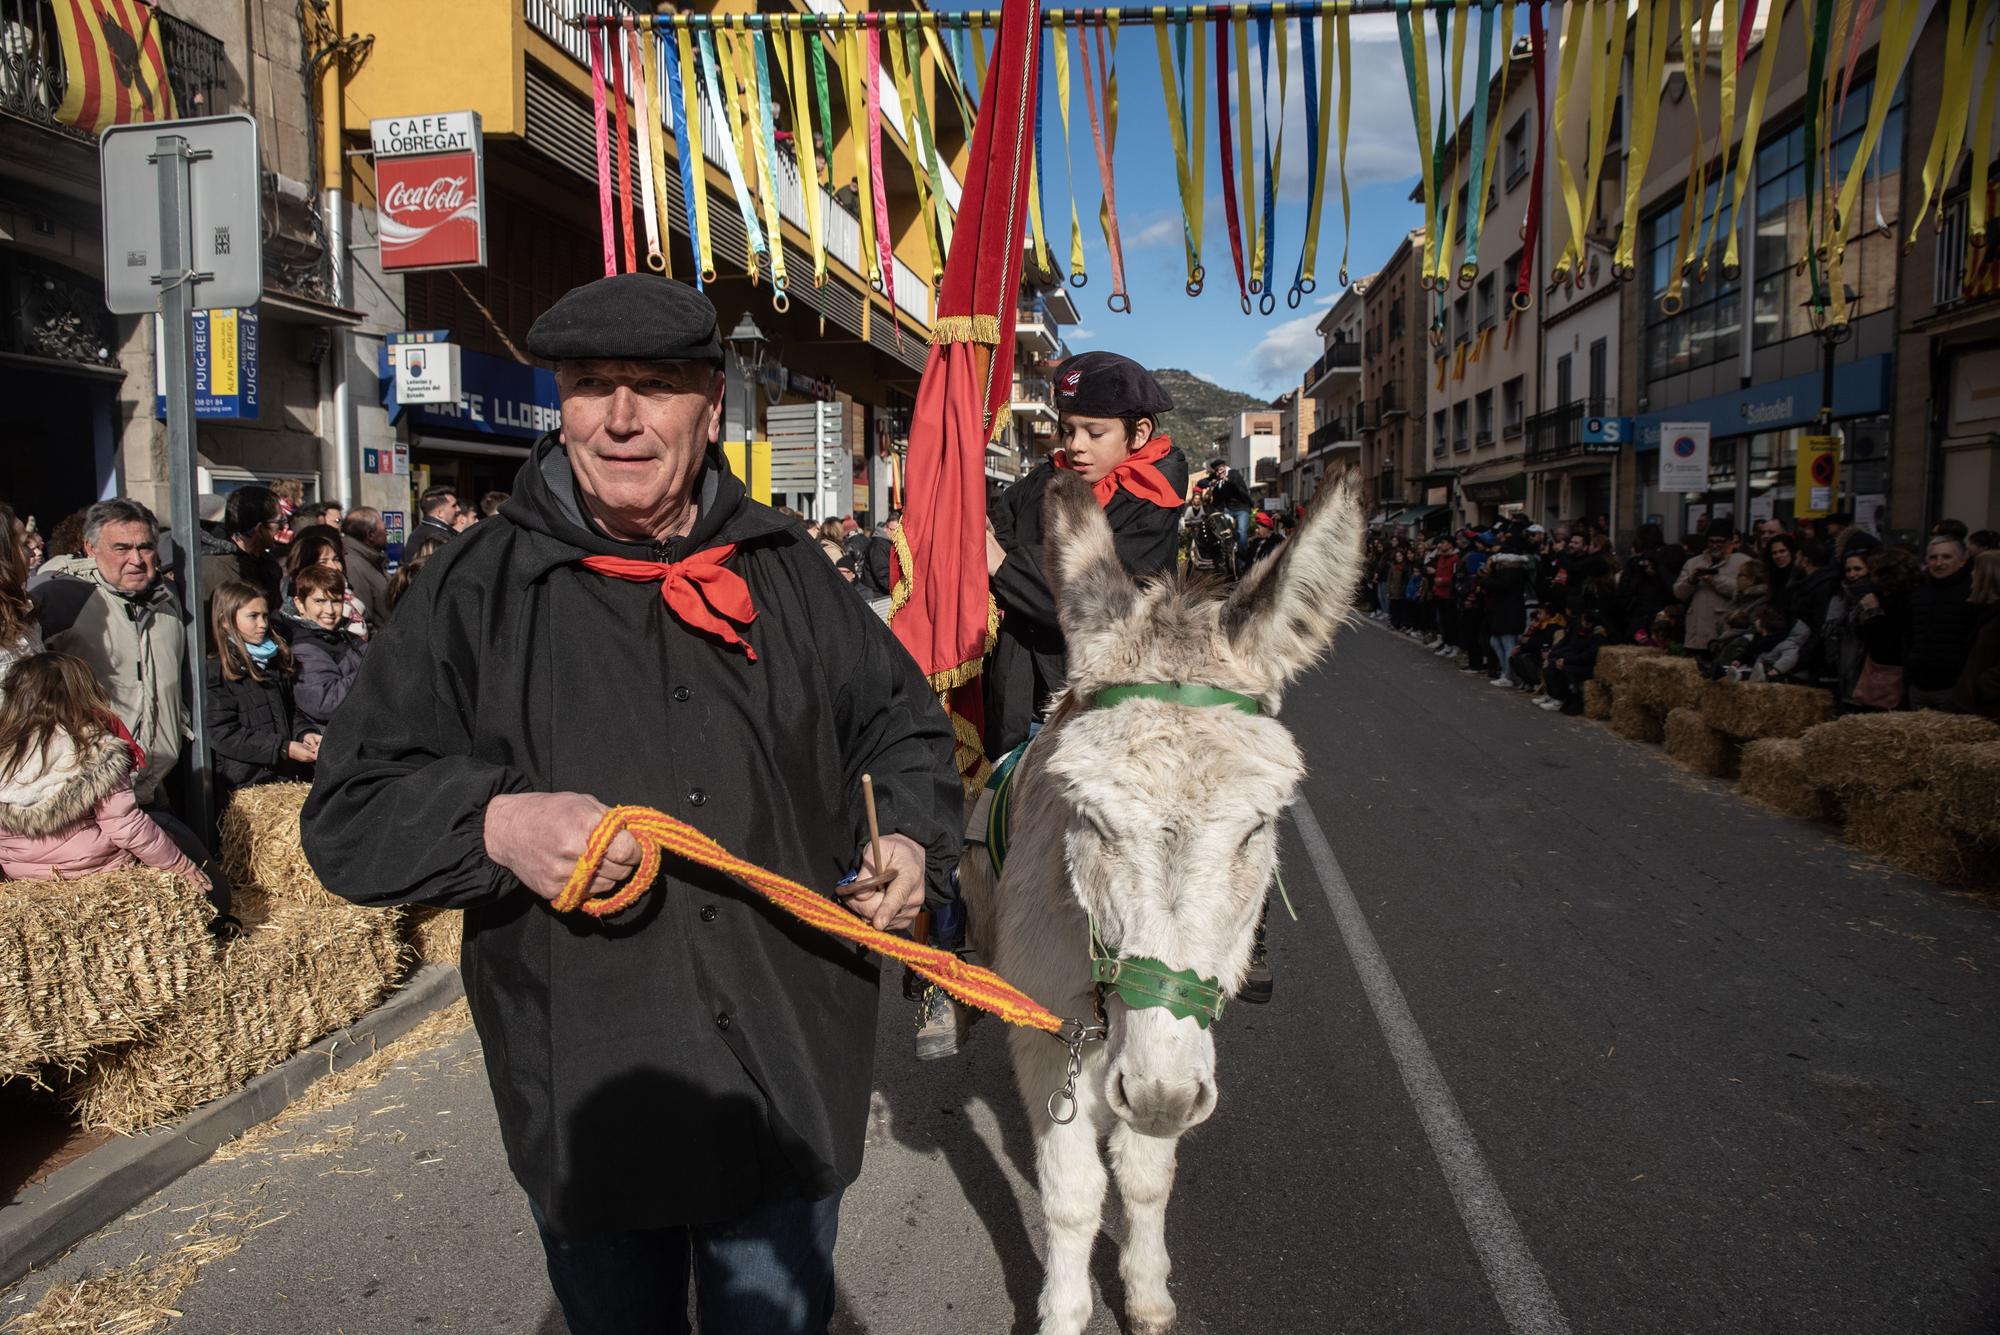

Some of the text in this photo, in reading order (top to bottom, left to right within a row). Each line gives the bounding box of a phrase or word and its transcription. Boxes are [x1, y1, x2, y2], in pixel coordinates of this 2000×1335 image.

[389, 117, 448, 136] CAFE
[373, 132, 467, 154] LLOBREGAT
[385, 176, 468, 214] Coca-Cola
[196, 320, 207, 390] PUIG-REIG
[247, 325, 256, 405] PUIG-REIG
[1603, 421, 1621, 441] S
